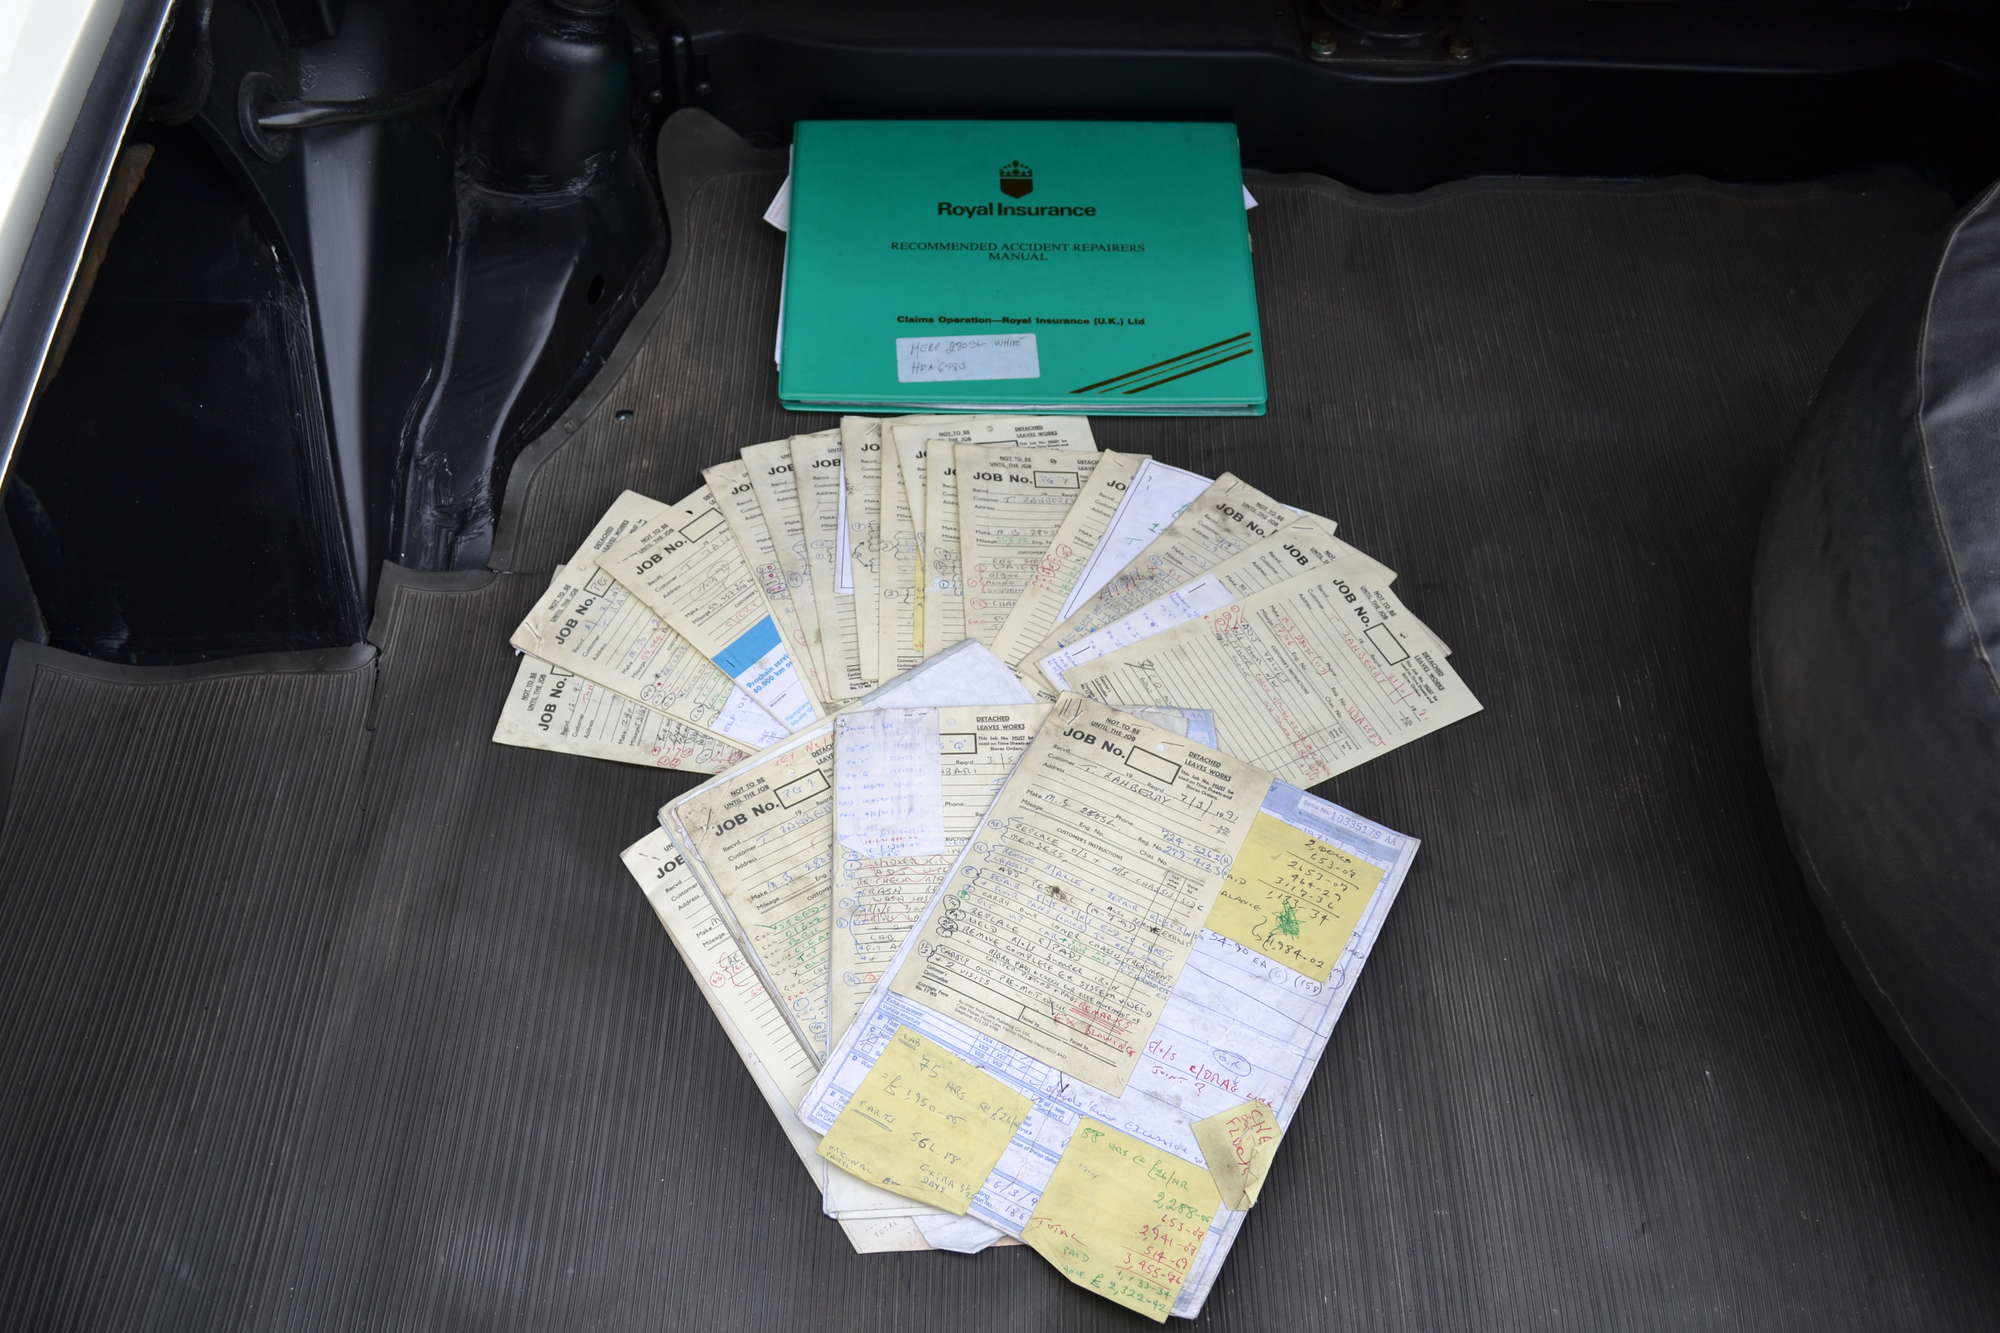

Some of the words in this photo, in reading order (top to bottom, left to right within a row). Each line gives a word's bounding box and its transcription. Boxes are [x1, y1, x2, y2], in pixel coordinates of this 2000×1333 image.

[937, 202, 993, 218] Royal
[998, 202, 1097, 216] Insurance
[891, 242, 997, 250] RECOMMENDED
[1001, 243, 1070, 251] ACCIDENT
[1073, 243, 1145, 252] REPAIRERS
[1036, 317, 1089, 325] Insurance
[1094, 317, 1124, 326] (U.K.)
[861, 443, 880, 451] JO
[973, 472, 1002, 481] JOB
[1009, 474, 1032, 484] No.
[1107, 480, 1130, 491] JO
[731, 483, 754, 495] JO
[1216, 498, 1243, 526] JOB
[1246, 519, 1266, 540] No.
[635, 552, 663, 575] JOB
[664, 536, 687, 554] No.
[1283, 541, 1308, 566] JOB
[1333, 577, 1356, 604] JOB
[1354, 605, 1373, 626] No.
[1359, 585, 1372, 599] UNTIL
[1370, 599, 1380, 609] THE
[1378, 609, 1388, 620] JOB
[1373, 589, 1384, 601] NOT
[1382, 601, 1390, 609] TO
[1388, 608, 1396, 617] BE
[554, 617, 578, 644] JOB
[575, 593, 596, 616] No.
[1422, 650, 1443, 677] DETACHED
[1414, 654, 1429, 672] LEAVES
[1428, 672, 1444, 691] WORKS
[537, 702, 556, 730] JOB
[549, 675, 566, 698] No.
[976, 714, 1009, 723] DETACHED
[976, 723, 999, 731] LEAVES
[1106, 717, 1119, 726] NOT
[1120, 722, 1129, 730] TO
[1131, 727, 1139, 735] BE
[1090, 719, 1109, 732] UNTIL
[1110, 728, 1121, 736] THE
[1123, 732, 1135, 742] JOB
[1063, 724, 1096, 747] JOB
[1101, 740, 1127, 758] No.
[1043, 761, 1064, 774] Address
[1048, 751, 1074, 767] Customer
[1188, 750, 1220, 769] DETACHED
[1184, 758, 1207, 773] LEAVES
[1208, 768, 1231, 782] WORKS
[730, 786, 745, 796] NOT
[746, 781, 755, 789] TO
[756, 776, 765, 784] BE
[1026, 788, 1042, 799] Make
[1211, 782, 1225, 792] MUST
[723, 797, 742, 810] UNTIL
[743, 790, 756, 800] THE
[757, 784, 769, 793] JOB
[1021, 798, 1043, 812] Mileage
[713, 812, 747, 836] JOB
[753, 798, 778, 816] No.
[1115, 814, 1133, 826] Phone
[1056, 827, 1086, 844] CUSTOMER'S
[1088, 841, 1122, 860] INSTRUCTIONS
[728, 844, 756, 861] Customer
[734, 856, 757, 870] Address
[670, 882, 698, 901] Customer
[751, 889, 767, 901] Make
[677, 894, 700, 910] Address
[757, 895, 779, 910] Mileage
[1221, 890, 1260, 912] ALANCE
[695, 925, 712, 938] Make
[702, 931, 725, 947] Mileage
